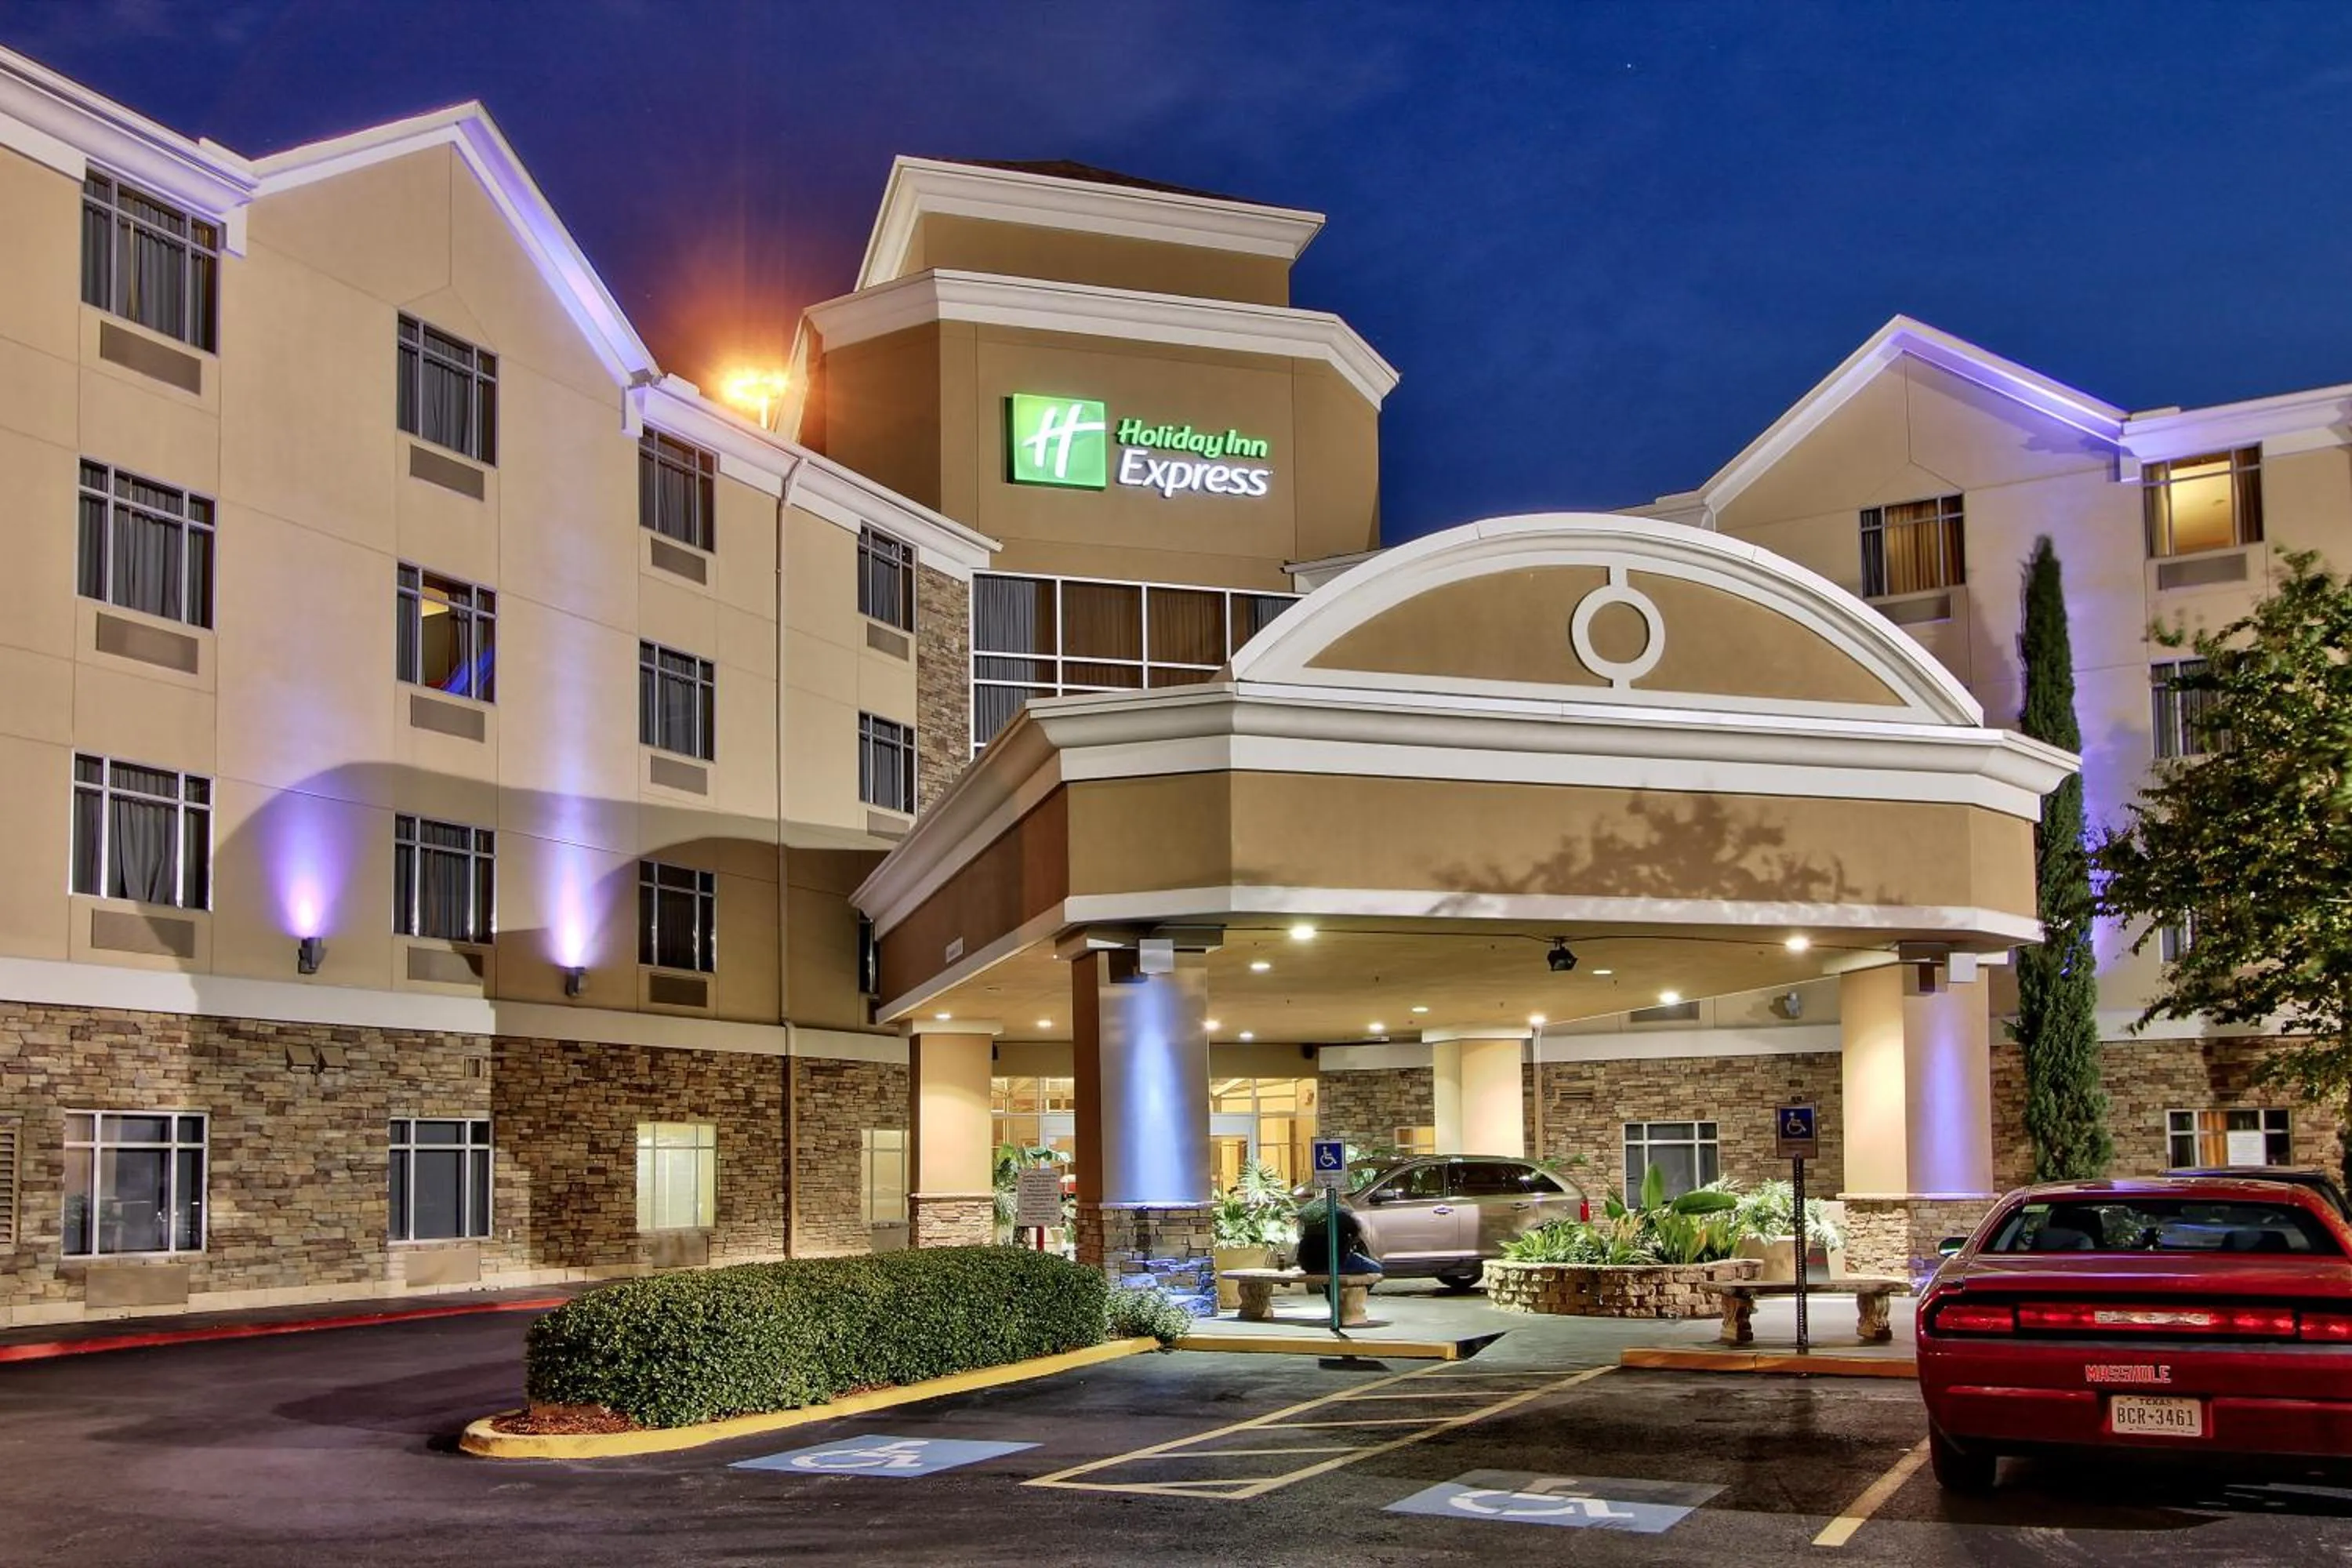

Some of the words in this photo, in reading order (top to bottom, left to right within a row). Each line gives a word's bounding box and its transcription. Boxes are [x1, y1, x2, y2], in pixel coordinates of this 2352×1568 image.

[1117, 417, 1224, 459] Holiday
[1225, 429, 1269, 458] Inn
[1118, 448, 1269, 499] Express
[2085, 1365, 2171, 1384] MASSHOLE
